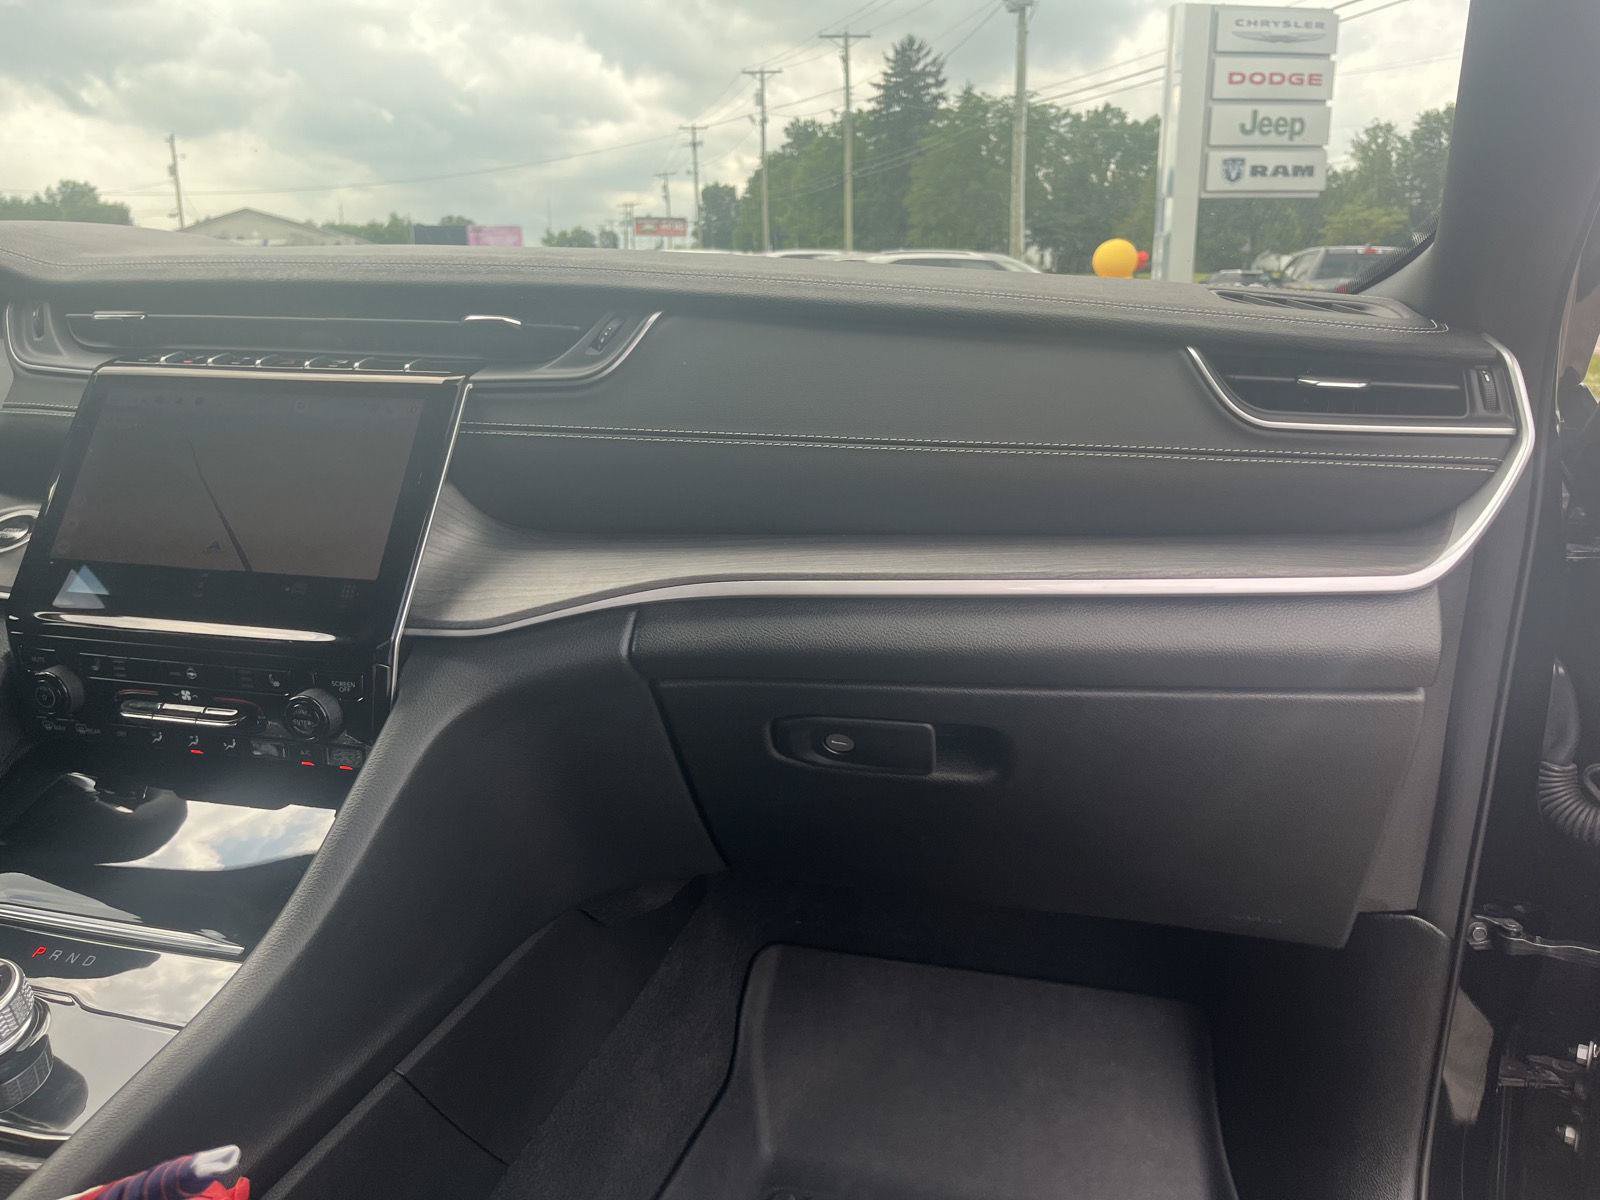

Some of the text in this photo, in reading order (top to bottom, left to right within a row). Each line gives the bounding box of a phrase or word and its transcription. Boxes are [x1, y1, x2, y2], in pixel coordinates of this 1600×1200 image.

[1235, 19, 1325, 29] CHRYSLER
[1228, 72, 1323, 86] DODGE
[1239, 109, 1305, 141] Jeep
[1249, 165, 1315, 177] RAM
[331, 680, 356, 688] SCREEN
[32, 946, 96, 966] P R N D
